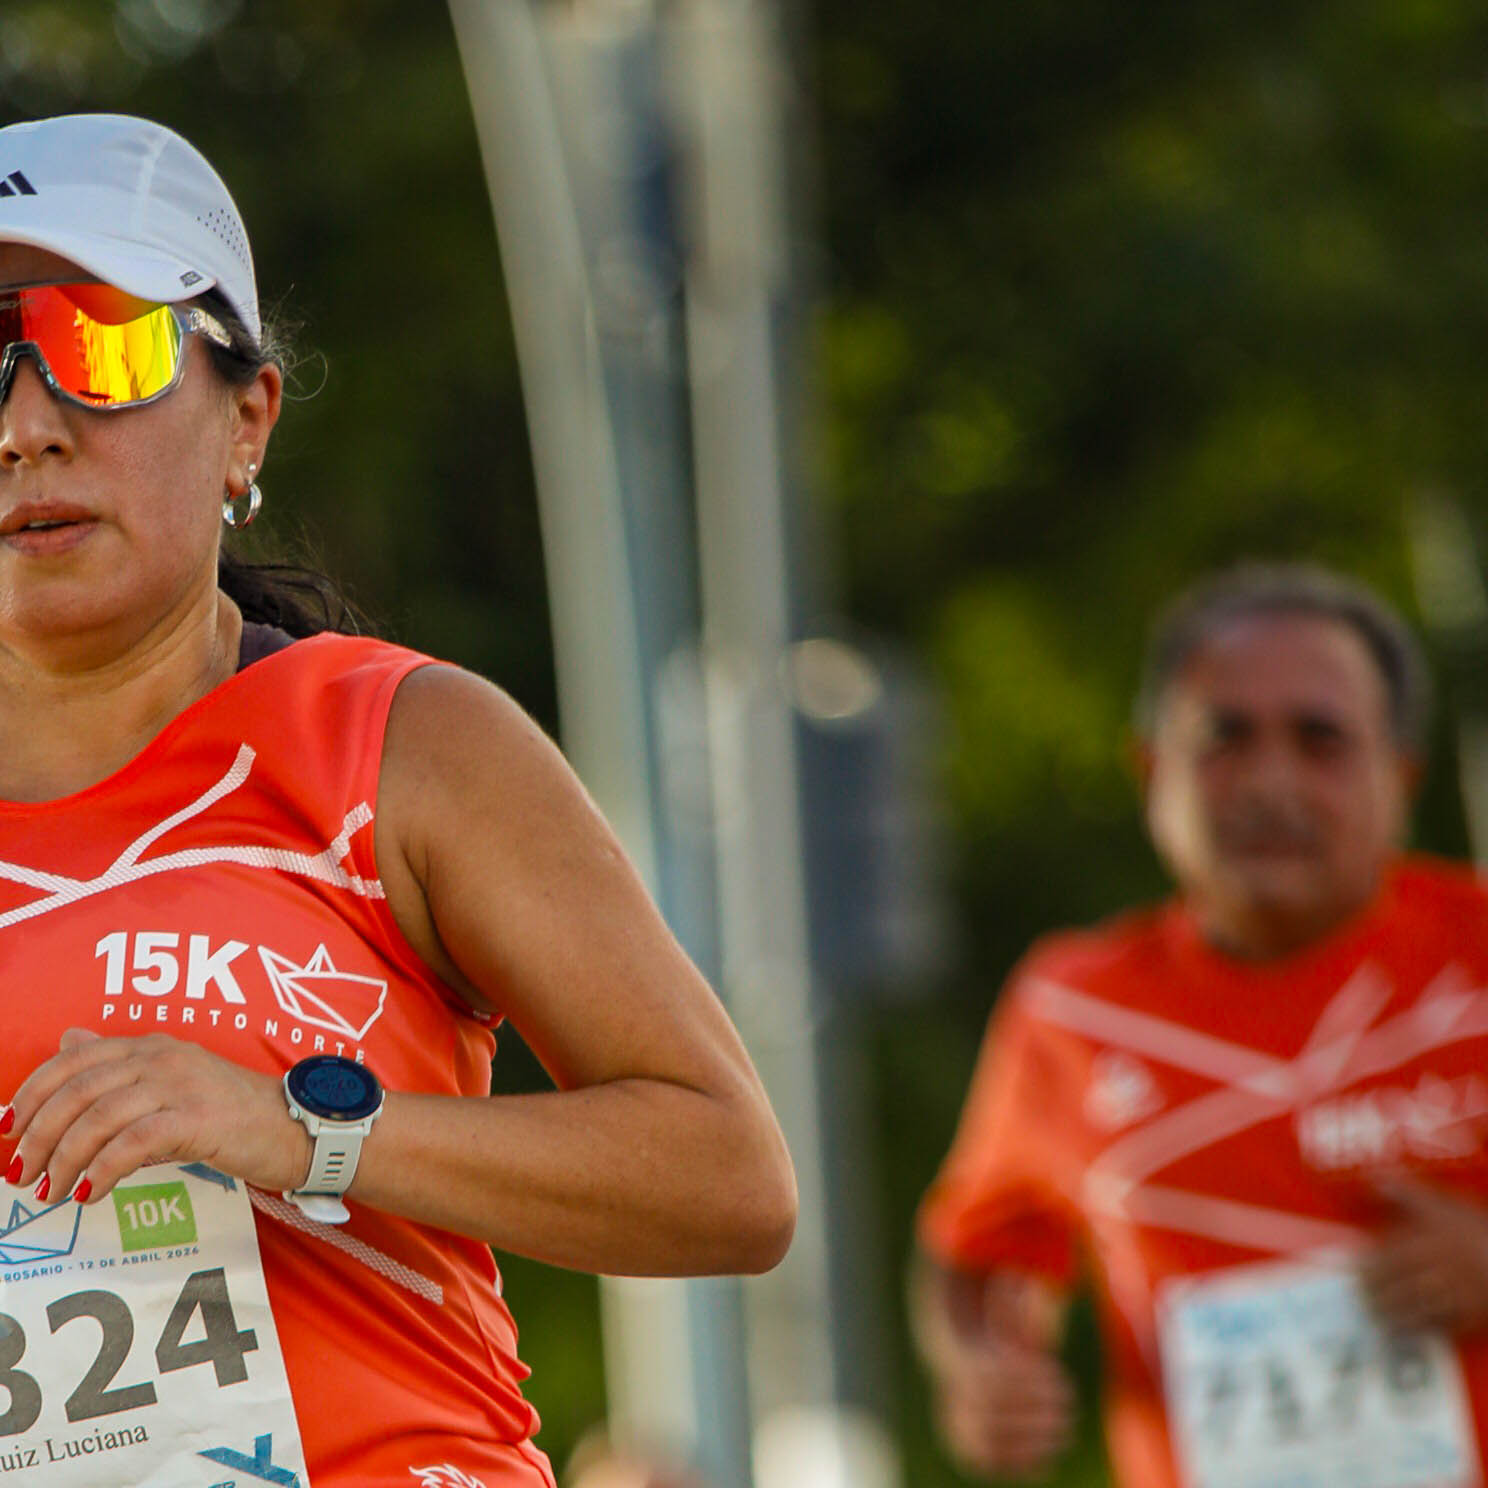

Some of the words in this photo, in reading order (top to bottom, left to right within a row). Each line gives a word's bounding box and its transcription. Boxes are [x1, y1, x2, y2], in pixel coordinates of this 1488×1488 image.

[95, 931, 250, 1004] 15K
[102, 1004, 248, 1029] PUERTO
[266, 1019, 366, 1065] NORTE
[123, 1194, 186, 1230] 10K
[4, 1264, 64, 1283] ROSARIO
[122, 1253, 162, 1266] ABRIL
[45, 1425, 150, 1463] Luciana
